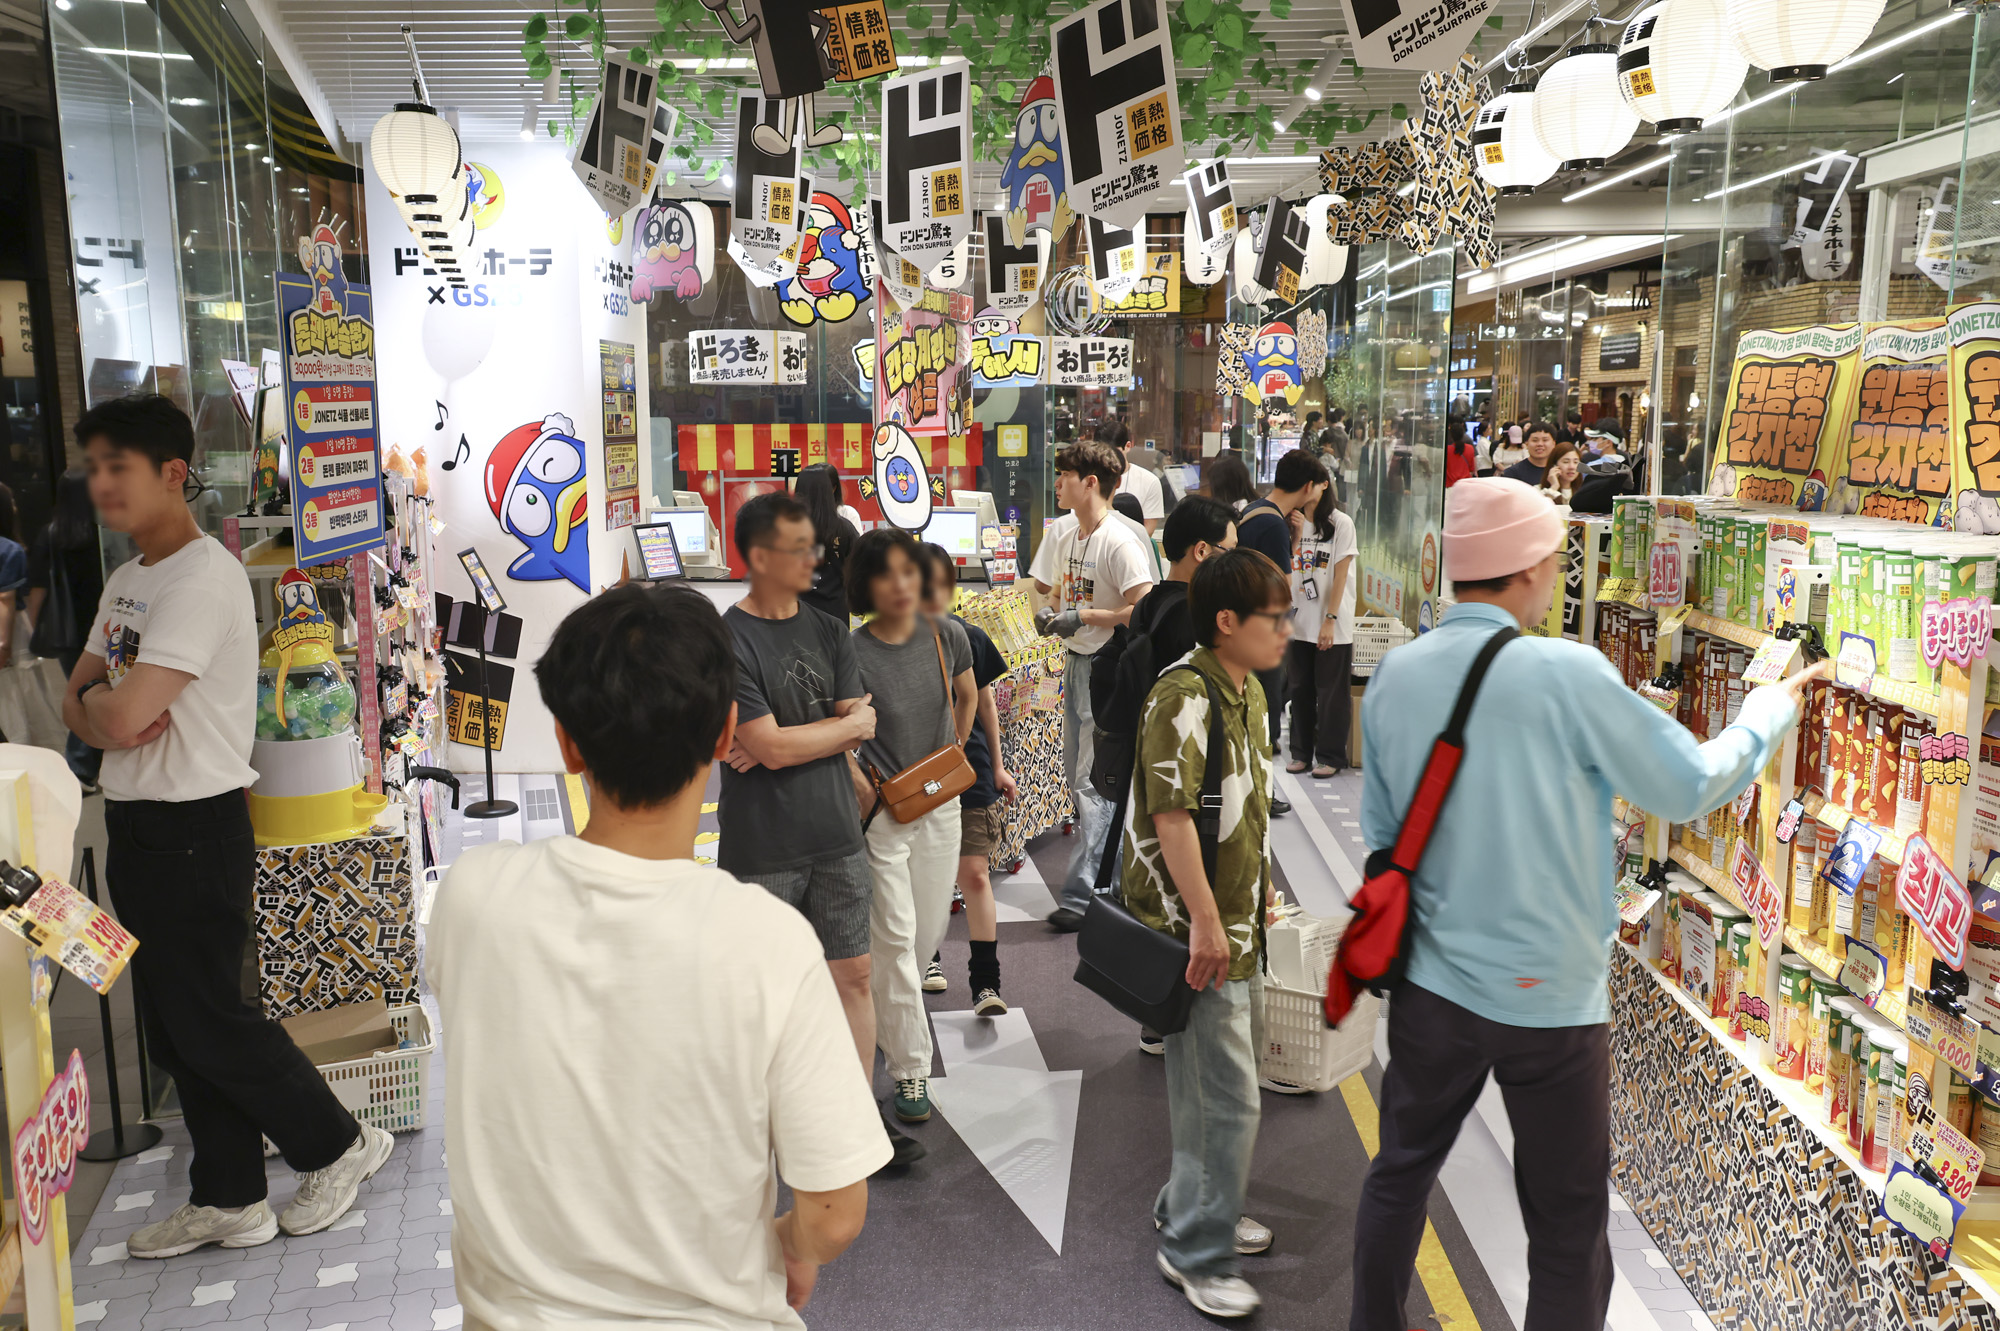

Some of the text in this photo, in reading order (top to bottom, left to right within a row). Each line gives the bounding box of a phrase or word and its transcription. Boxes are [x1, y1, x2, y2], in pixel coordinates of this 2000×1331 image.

[845, 8, 885, 39] 情熱
[1393, 1, 1489, 63] DON DON SURPRISE
[853, 38, 891, 71] 価格
[1631, 72, 1650, 84] 情熱
[1633, 83, 1653, 95] 価格
[1131, 101, 1165, 130] 情熱
[1114, 115, 1128, 165] JONETZ
[1134, 124, 1167, 152] 価格
[771, 185, 792, 203] 情熱
[934, 174, 959, 193] 情熱
[1091, 164, 1159, 203] ドンドン驚キ
[922, 174, 930, 219] JONETZ
[935, 193, 960, 212] 価格
[1094, 180, 1160, 212] DON DON SURPRISE
[771, 205, 791, 225] 価格
[744, 226, 781, 244] ドンドン驚キ
[900, 222, 952, 244] ドンドン驚キ
[761, 242, 781, 251] SURPRISE
[900, 239, 953, 252] DON DON SURPRISE
[902, 273, 919, 286] 価格
[1021, 268, 1036, 278] 情熱
[1021, 278, 1036, 290] 価格
[610, 292, 629, 317] GS25
[999, 294, 1029, 306] ドンドン驚キ
[882, 308, 903, 334] 순식간에
[294, 308, 374, 361] 돈펜캡슐뽑기
[1738, 328, 1863, 356] JONETZ에서 가장 많이 팔리는 감자칩
[1863, 334, 1930, 357] JONETZ에서 가장
[323, 386, 331, 400] 1일
[332, 386, 341, 398] 5명
[1737, 360, 1836, 418] 원통형
[298, 402, 309, 419] 1등
[314, 407, 370, 423] JONETZ 식품 선물세트
[326, 438, 335, 452] 1일
[335, 437, 345, 451] 10명
[1728, 412, 1825, 474] 감자칩
[300, 457, 314, 474] 2등
[322, 459, 369, 478] 돈펜 클리어 파우치
[779, 454, 788, 472] 1
[305, 512, 318, 529] 3등
[329, 509, 369, 530] 반짝반짝 스티커
[1652, 552, 1680, 598] 최고
[1926, 607, 1988, 657] 좋아좋아
[1788, 800, 1804, 816] SNS
[1736, 848, 1779, 938] 대박
[1903, 847, 1965, 952] 최고
[18, 1059, 86, 1226] 좋아좋아
[1913, 1131, 1935, 1152] 군고구마
[1937, 1160, 1973, 1200] 3,300
[1892, 1195, 1911, 1212] 수량은
[1900, 1189, 1939, 1221] 1인 구매 가능
